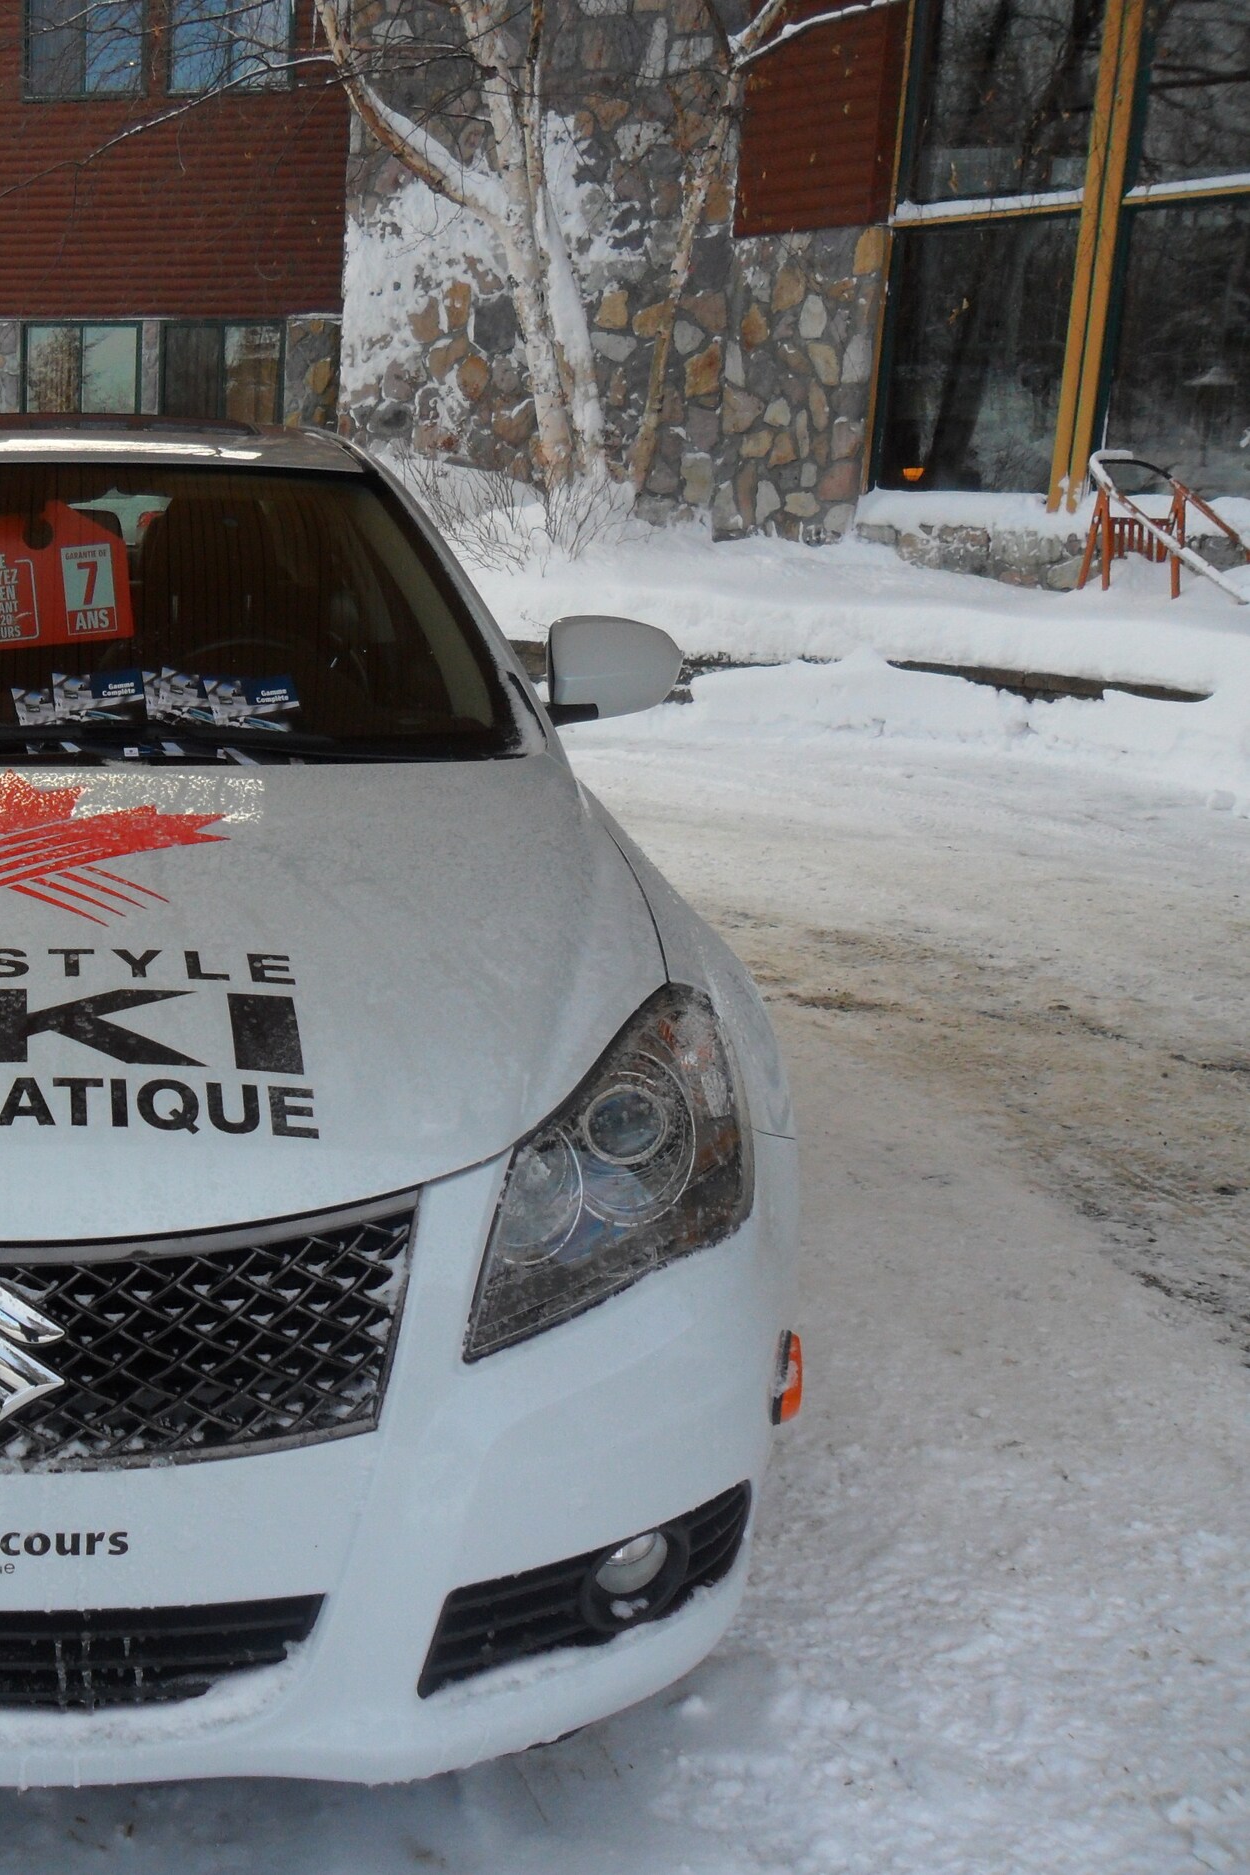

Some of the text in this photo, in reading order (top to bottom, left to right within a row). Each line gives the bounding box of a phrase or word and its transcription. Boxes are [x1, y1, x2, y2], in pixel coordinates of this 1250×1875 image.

[65, 549, 107, 560] GARANTIE DE
[77, 561, 98, 606] 7
[75, 609, 110, 630] ANS
[108, 681, 135, 690] Gamme
[101, 687, 136, 697] Complète
[260, 688, 287, 697] Gamme
[255, 694, 289, 704] Complète
